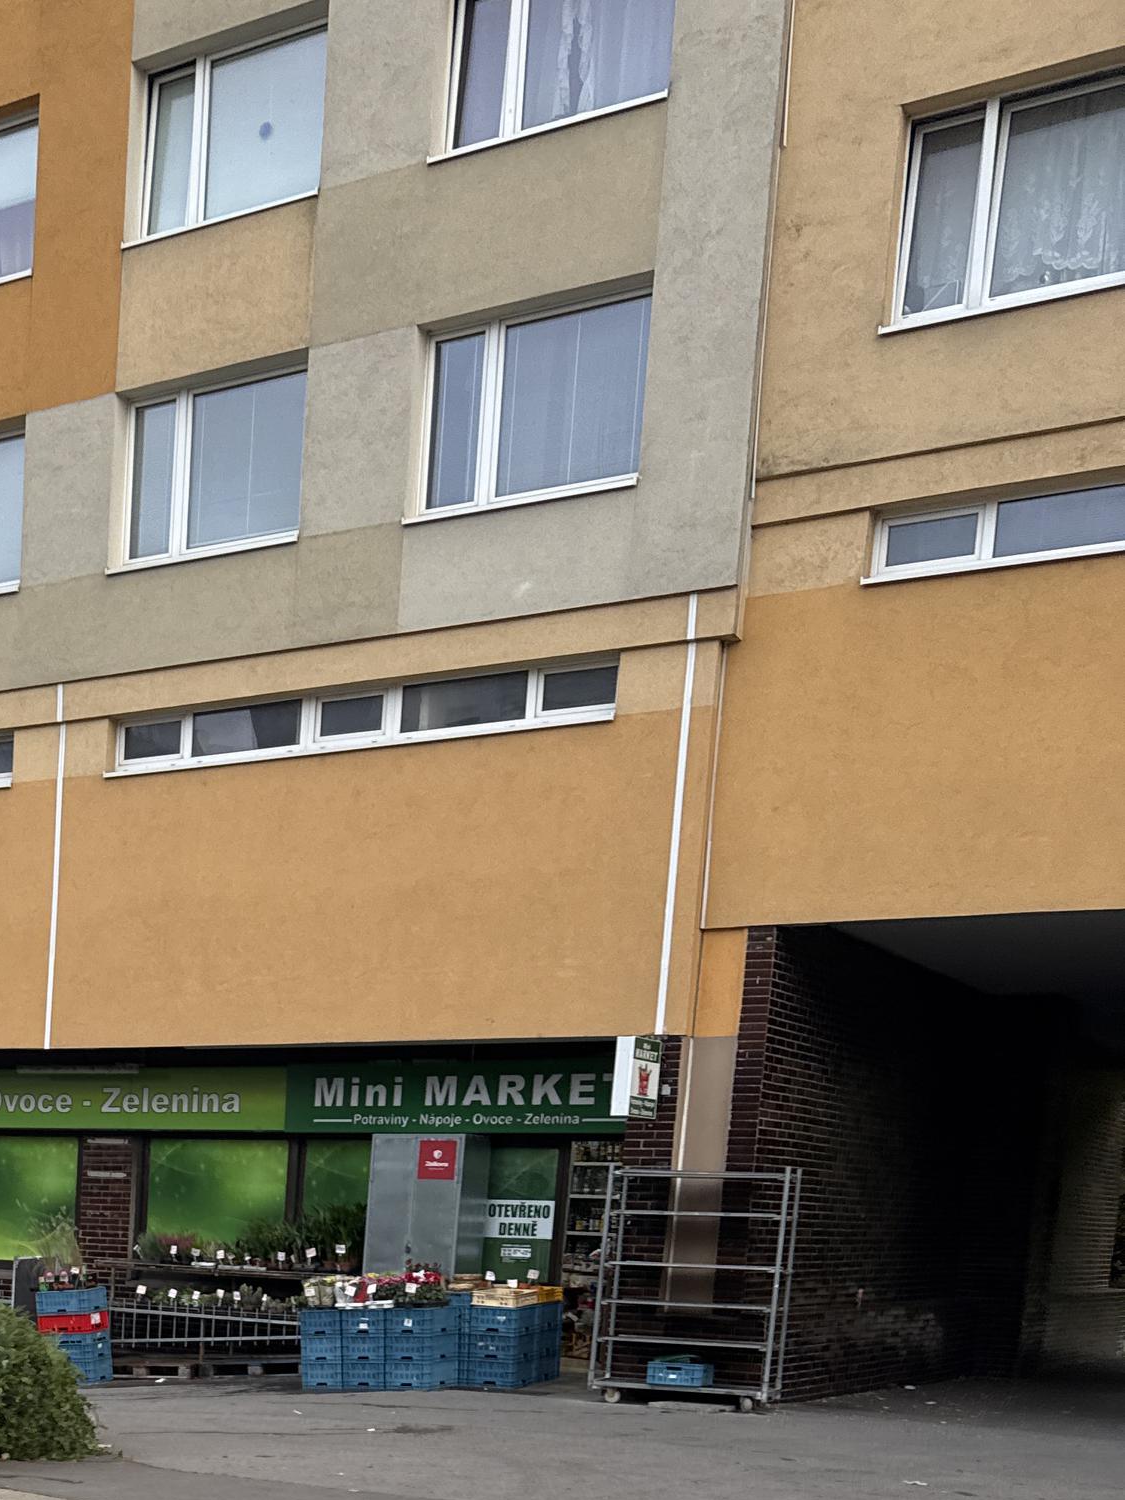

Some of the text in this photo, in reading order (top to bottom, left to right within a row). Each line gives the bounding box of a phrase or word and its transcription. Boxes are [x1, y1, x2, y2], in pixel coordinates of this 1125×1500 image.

[313, 1073, 614, 1107] Mini MARKE
[100, 1087, 241, 1114] Zelenina
[353, 1114, 409, 1127] Potraviny
[419, 1113, 462, 1127] Nápoje
[473, 1114, 513, 1125] Ovoce
[524, 1113, 580, 1125] Zelenina
[488, 1202, 551, 1219] OTEVŘENO
[499, 1221, 538, 1237] DENNĚ
